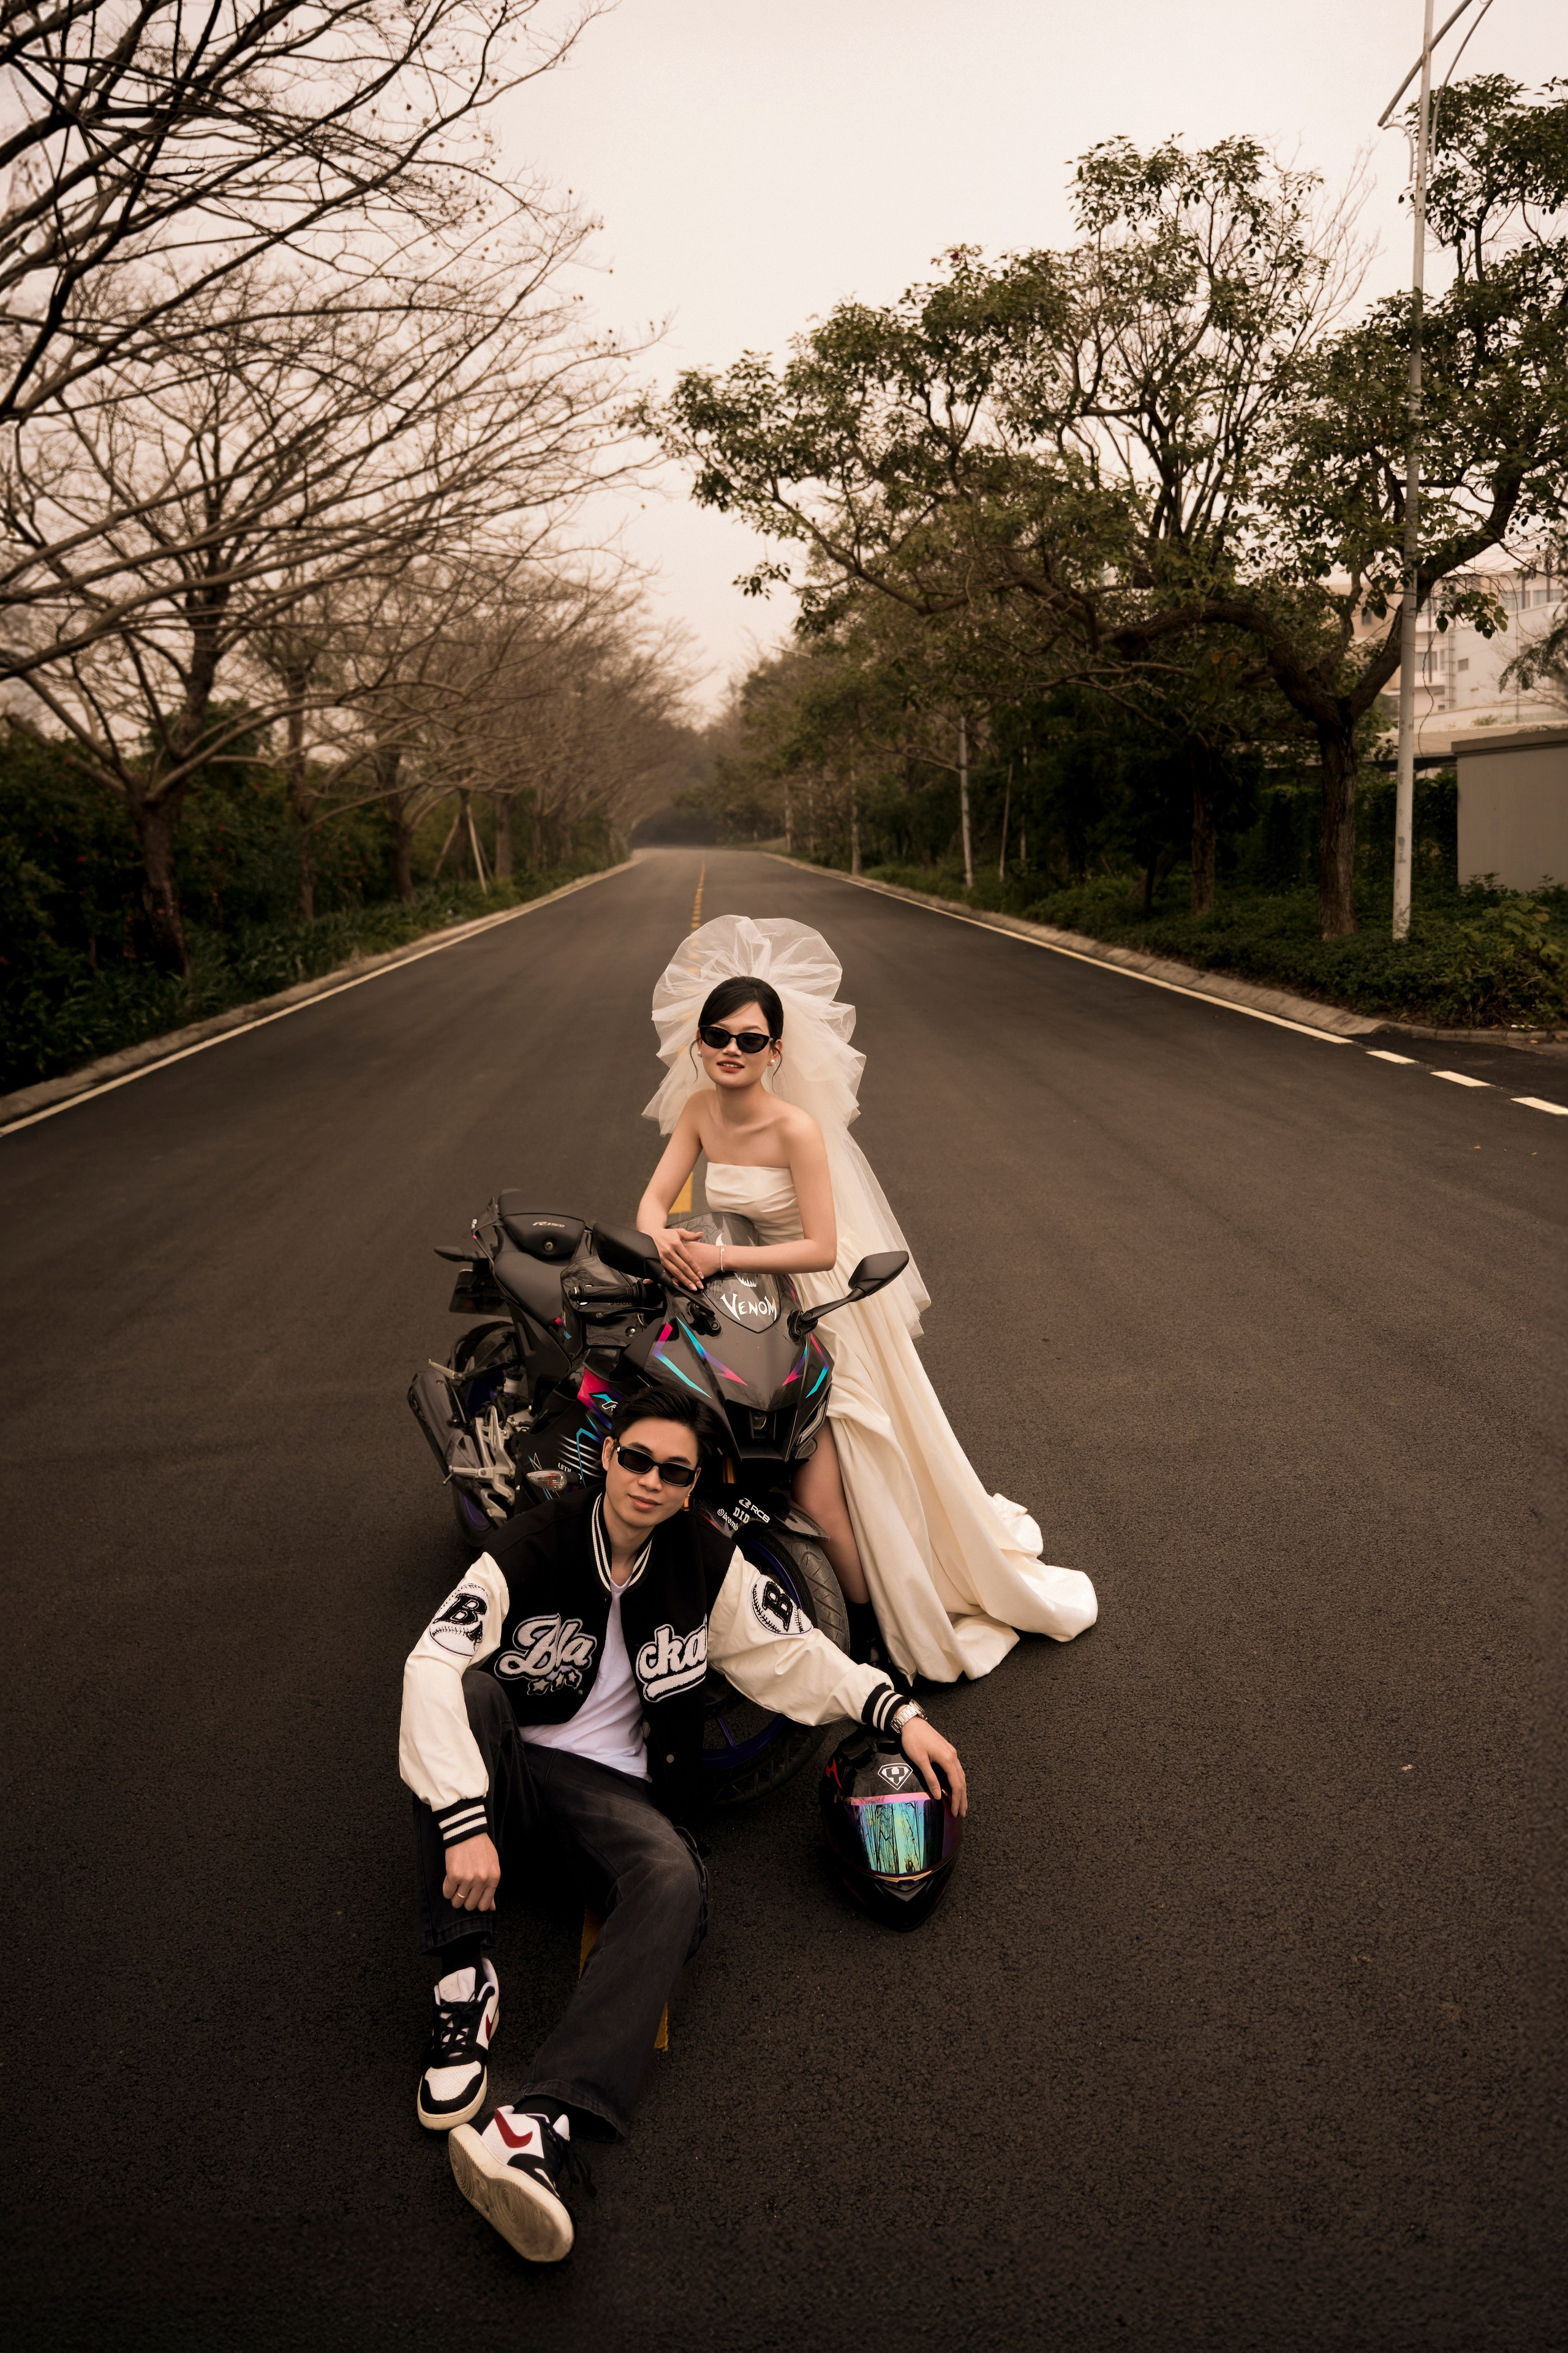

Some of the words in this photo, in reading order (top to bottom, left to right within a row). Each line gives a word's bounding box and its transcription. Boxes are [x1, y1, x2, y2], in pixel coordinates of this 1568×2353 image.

[720, 1293, 777, 1321] VENOM
[722, 1512, 739, 1531] bremb
[750, 1505, 770, 1523] RCB
[432, 1593, 488, 1625] B
[762, 1581, 793, 1632] B
